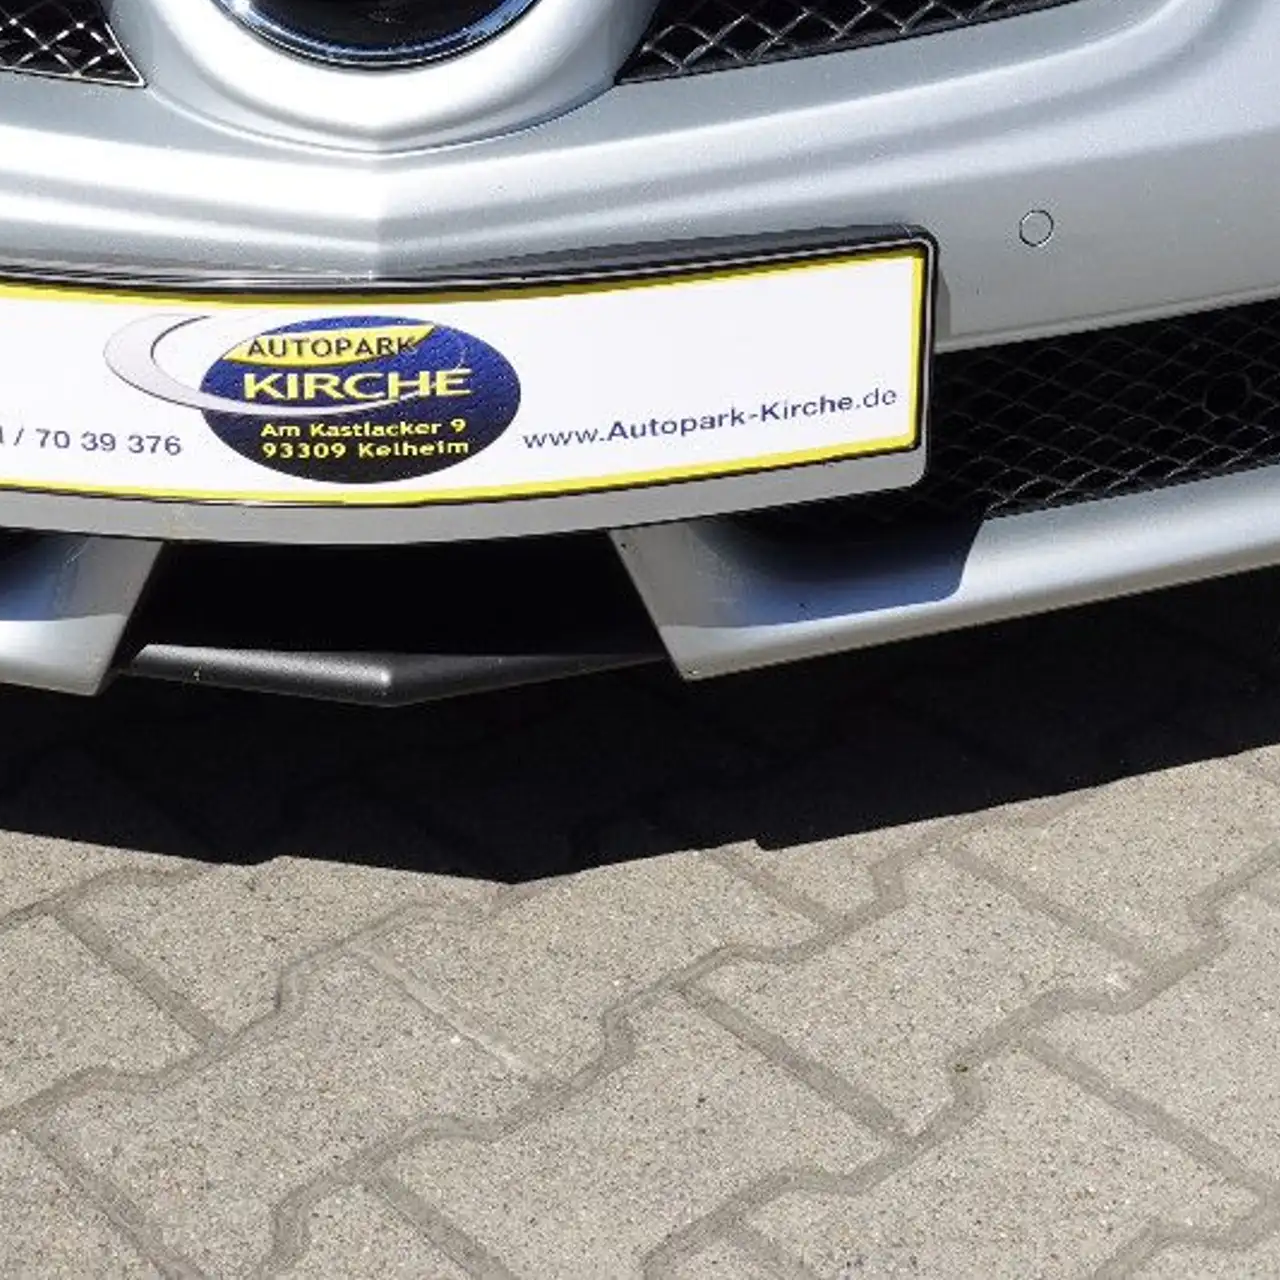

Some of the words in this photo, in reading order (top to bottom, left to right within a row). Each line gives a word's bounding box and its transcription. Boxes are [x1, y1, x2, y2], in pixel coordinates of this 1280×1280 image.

[248, 336, 417, 357] AUTOPARK
[243, 368, 472, 401] KIRCHE
[260, 424, 301, 438] Am
[310, 419, 442, 437] Kastlacker
[450, 418, 467, 434] 9
[523, 387, 897, 449] www.Autopark-Kirche.de
[36, 428, 71, 451] 70
[82, 431, 117, 453] 39
[128, 434, 182, 457] 376
[262, 441, 347, 459] 93309
[358, 440, 469, 458] Kelheim
